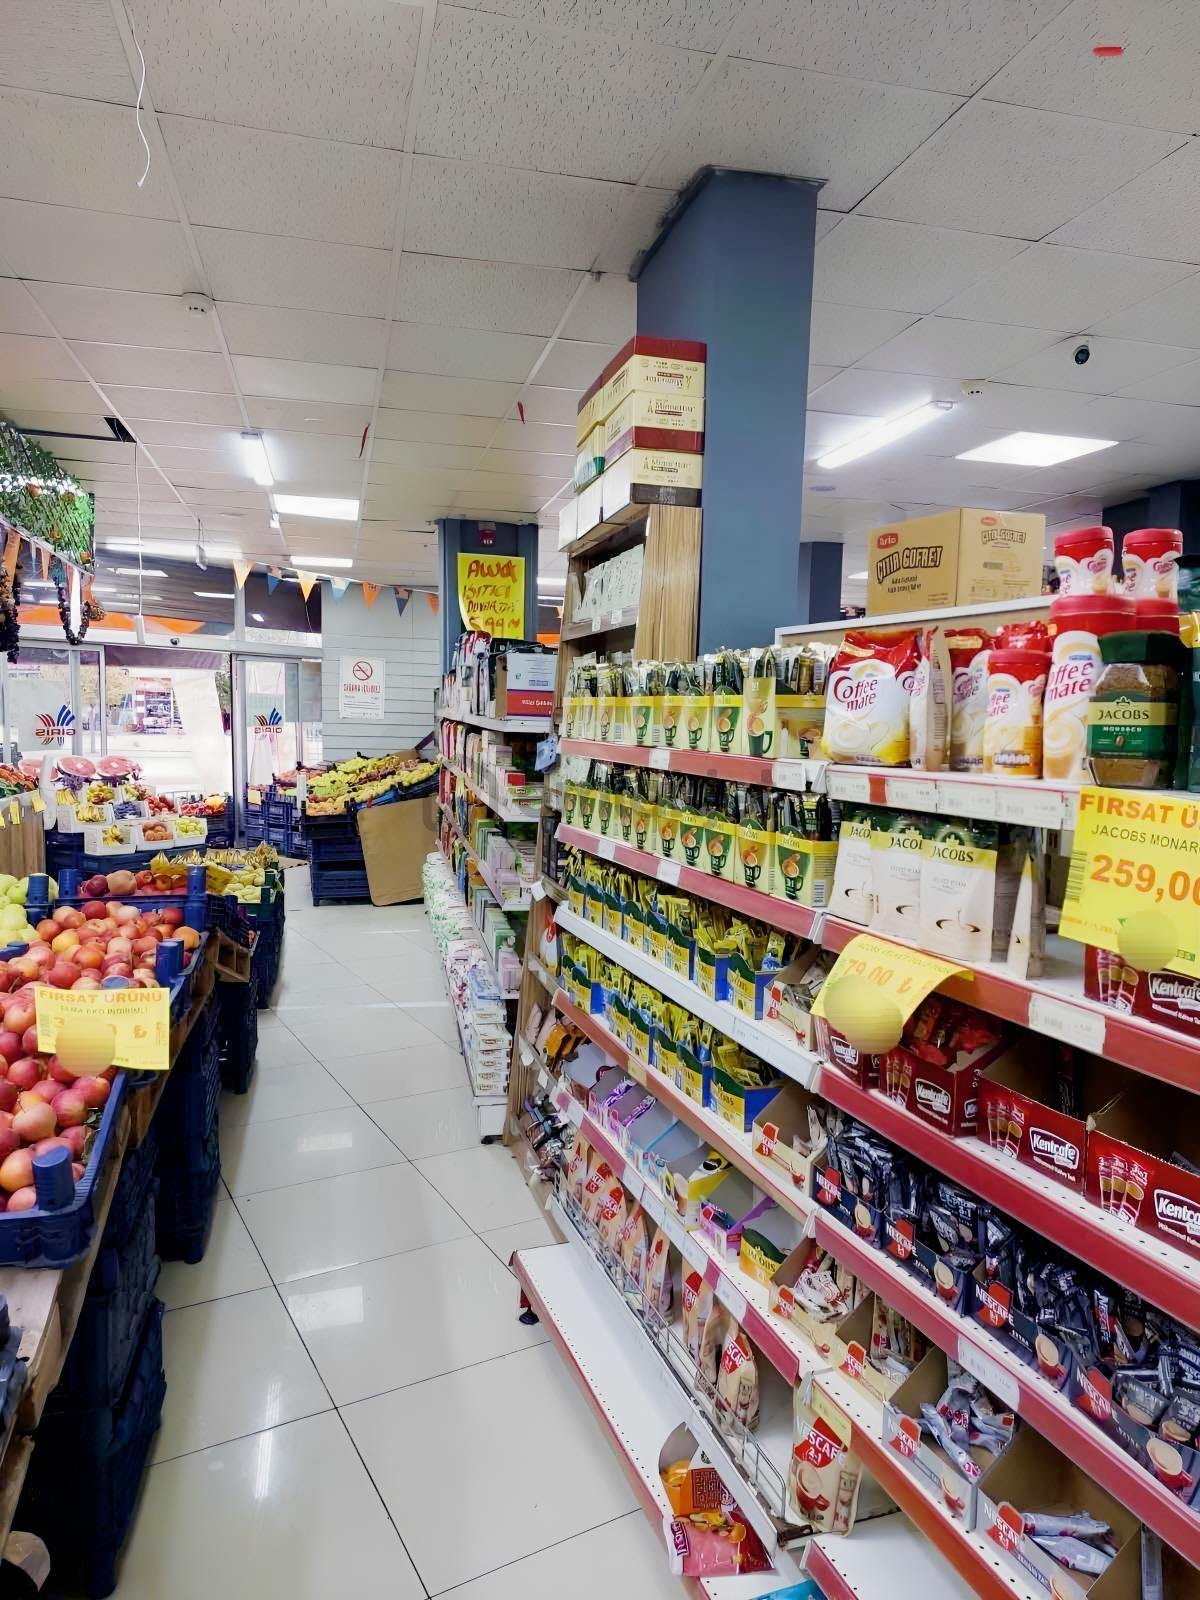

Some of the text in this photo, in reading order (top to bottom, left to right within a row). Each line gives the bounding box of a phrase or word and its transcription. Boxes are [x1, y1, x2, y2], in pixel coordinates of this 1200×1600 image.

[902, 546, 943, 568] GOFRET
[834, 676, 878, 703] Coffee
[847, 693, 876, 712] mate
[1098, 709, 1150, 720] JACOBS
[1080, 793, 1174, 825] FIRSAT
[850, 826, 871, 839] JACO
[1092, 824, 1200, 855] JACOBS MONAR
[932, 846, 974, 863] JACOBS
[39, 990, 98, 1003] FIRSAT
[1033, 1133, 1076, 1159] Kentcafe
